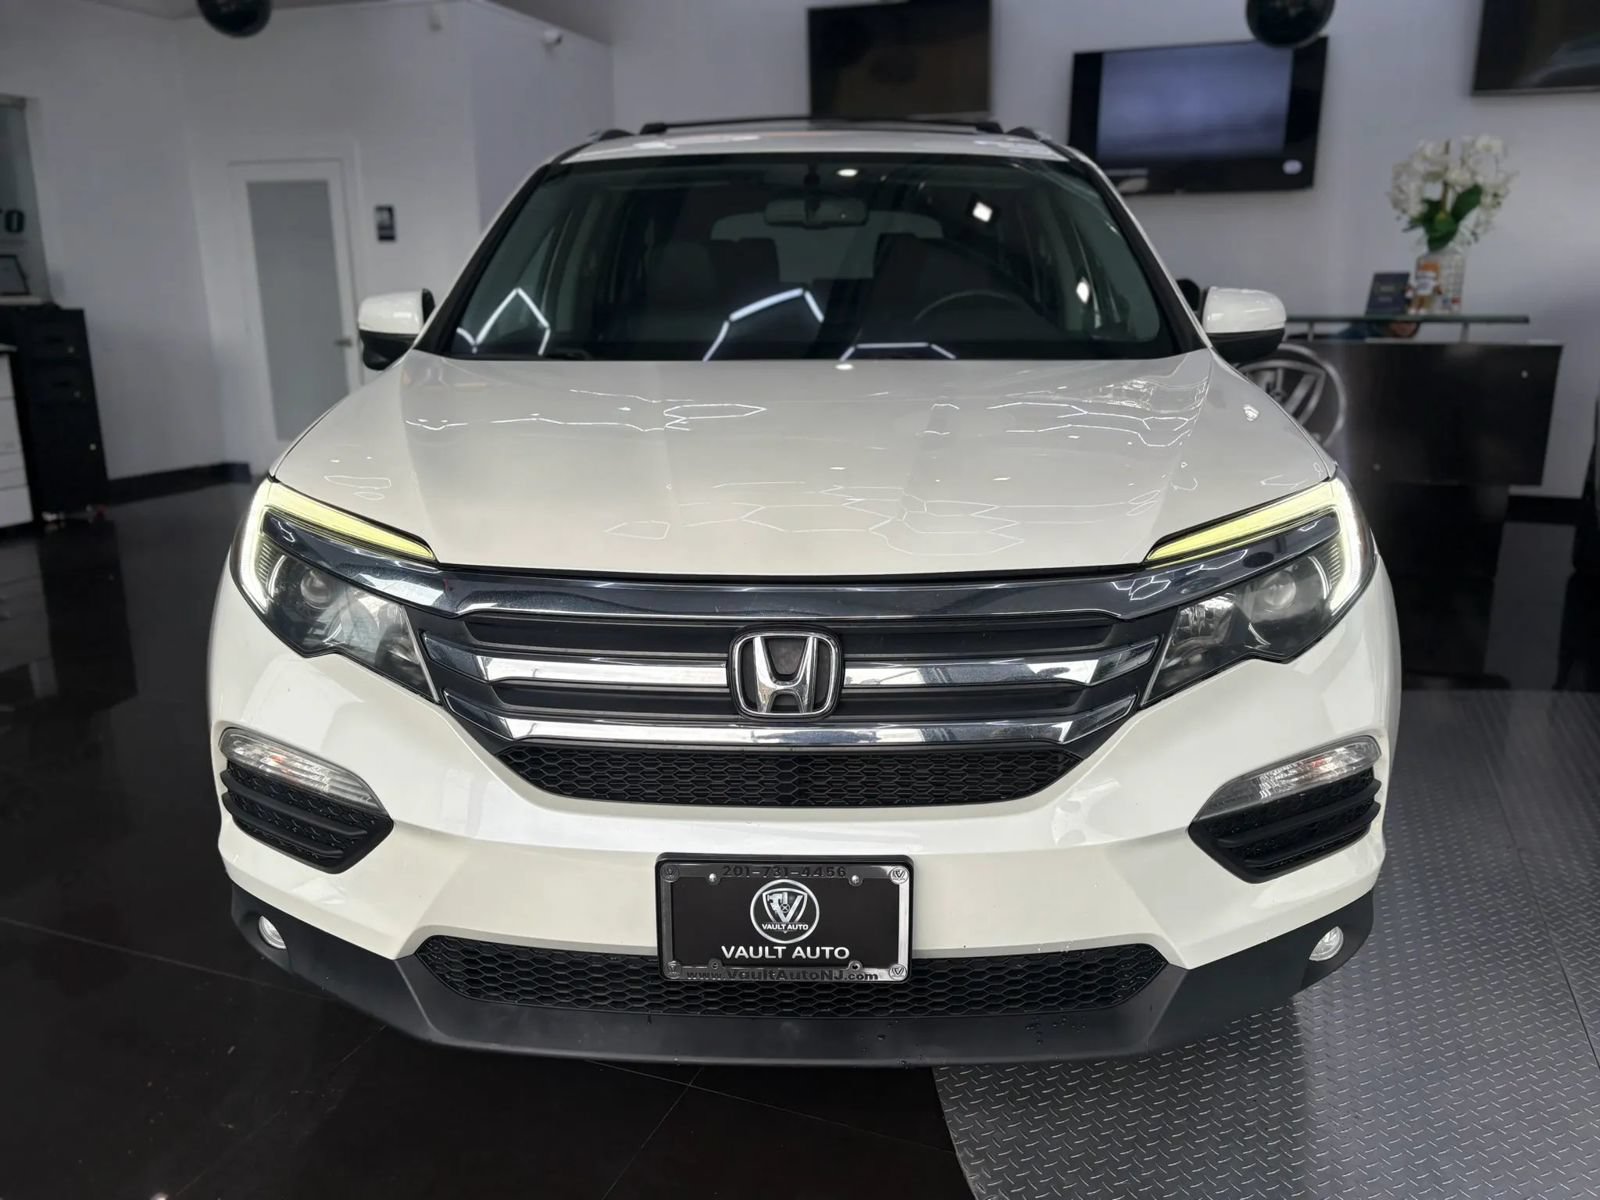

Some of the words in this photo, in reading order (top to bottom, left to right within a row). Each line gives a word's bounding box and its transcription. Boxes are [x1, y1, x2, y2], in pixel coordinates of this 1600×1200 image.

[722, 864, 847, 878] 201-731-4456
[761, 923, 786, 931] VAULT
[787, 923, 809, 931] AUTO
[721, 945, 786, 959] VAULT
[791, 945, 850, 960] AUTO
[686, 968, 879, 981] www.VaultAutoNJ.com
